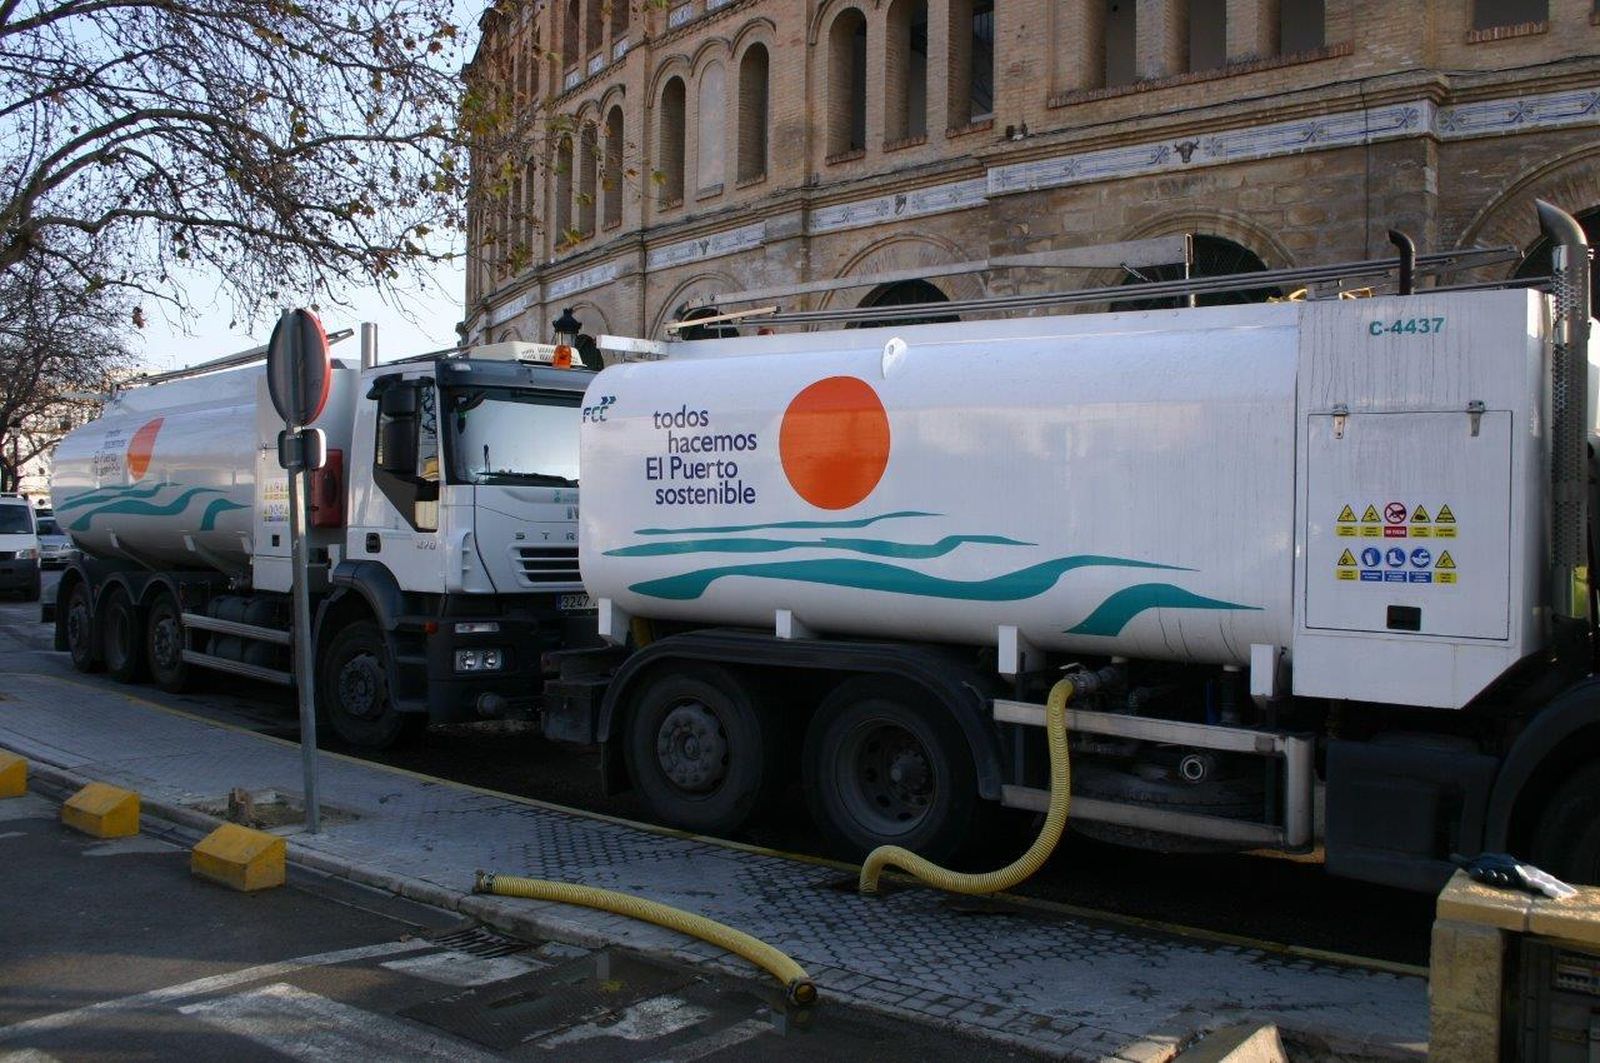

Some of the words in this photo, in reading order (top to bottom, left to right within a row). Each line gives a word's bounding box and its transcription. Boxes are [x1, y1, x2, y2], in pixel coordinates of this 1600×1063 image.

[1369, 317, 1445, 336] C-4437
[583, 406, 609, 423] FCC
[653, 404, 709, 430] todos
[668, 430, 757, 454] hacemos
[646, 457, 663, 480] El
[670, 456, 738, 480] Puerto
[655, 480, 756, 505] sostenible
